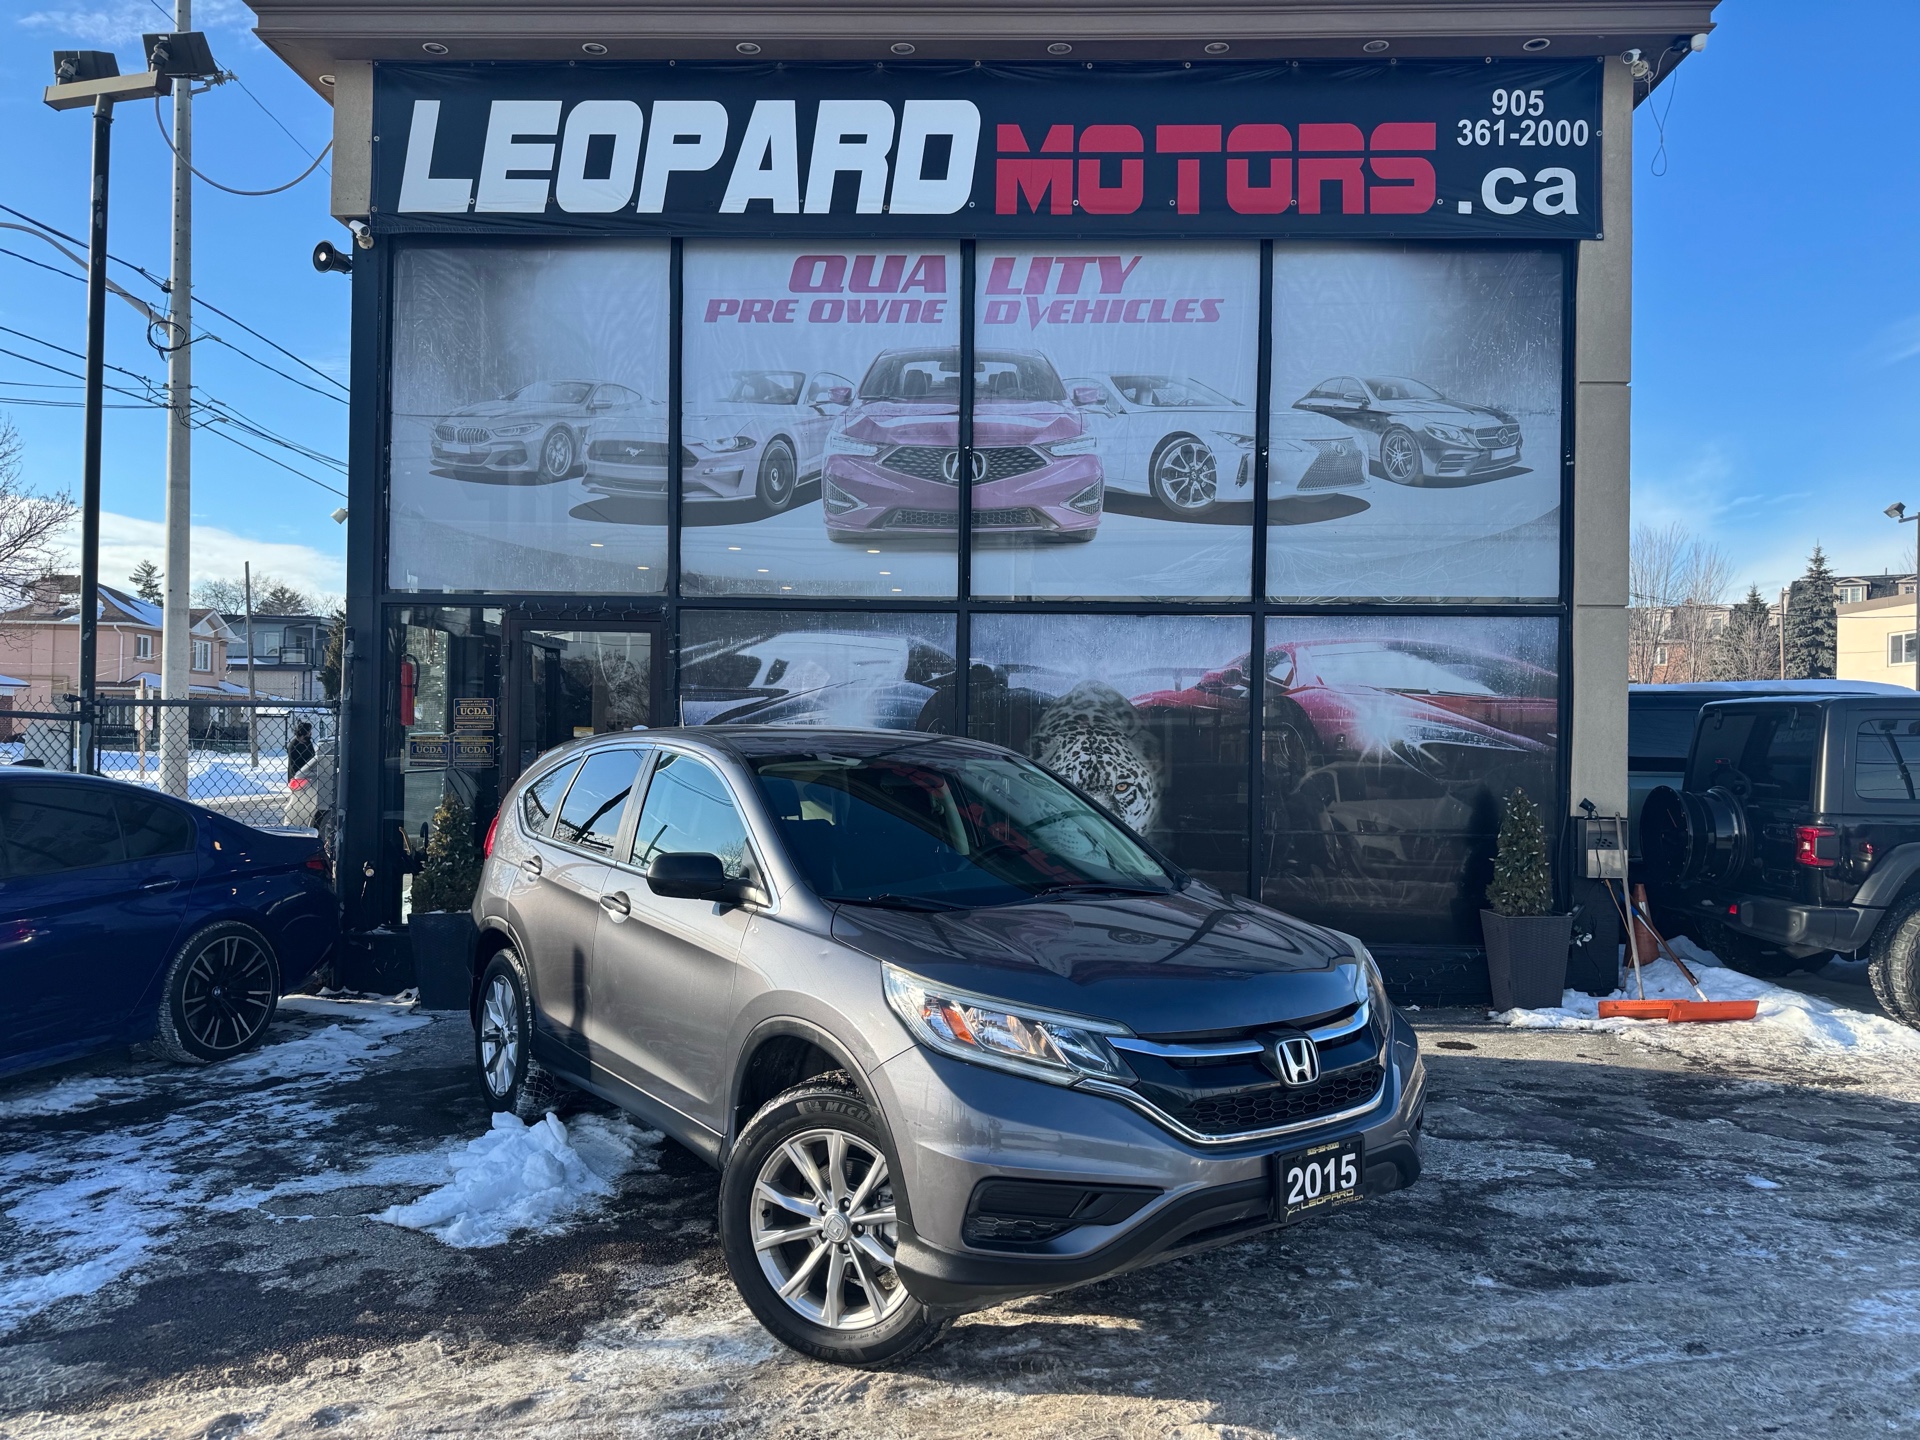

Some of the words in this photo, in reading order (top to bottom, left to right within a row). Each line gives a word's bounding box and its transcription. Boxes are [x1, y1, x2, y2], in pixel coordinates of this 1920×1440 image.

[1491, 89, 1545, 117] 905
[1457, 118, 1589, 147] 361-2000
[397, 99, 982, 214] LEOPARD
[995, 122, 1437, 215] MOTORS
[704, 297, 799, 323] PRE
[460, 707, 488, 715] UCDA
[416, 746, 443, 754] UCDA
[460, 746, 488, 754] UCDA
[1287, 1152, 1357, 1204] 2015
[1300, 1188, 1354, 1210] LEOPARD
